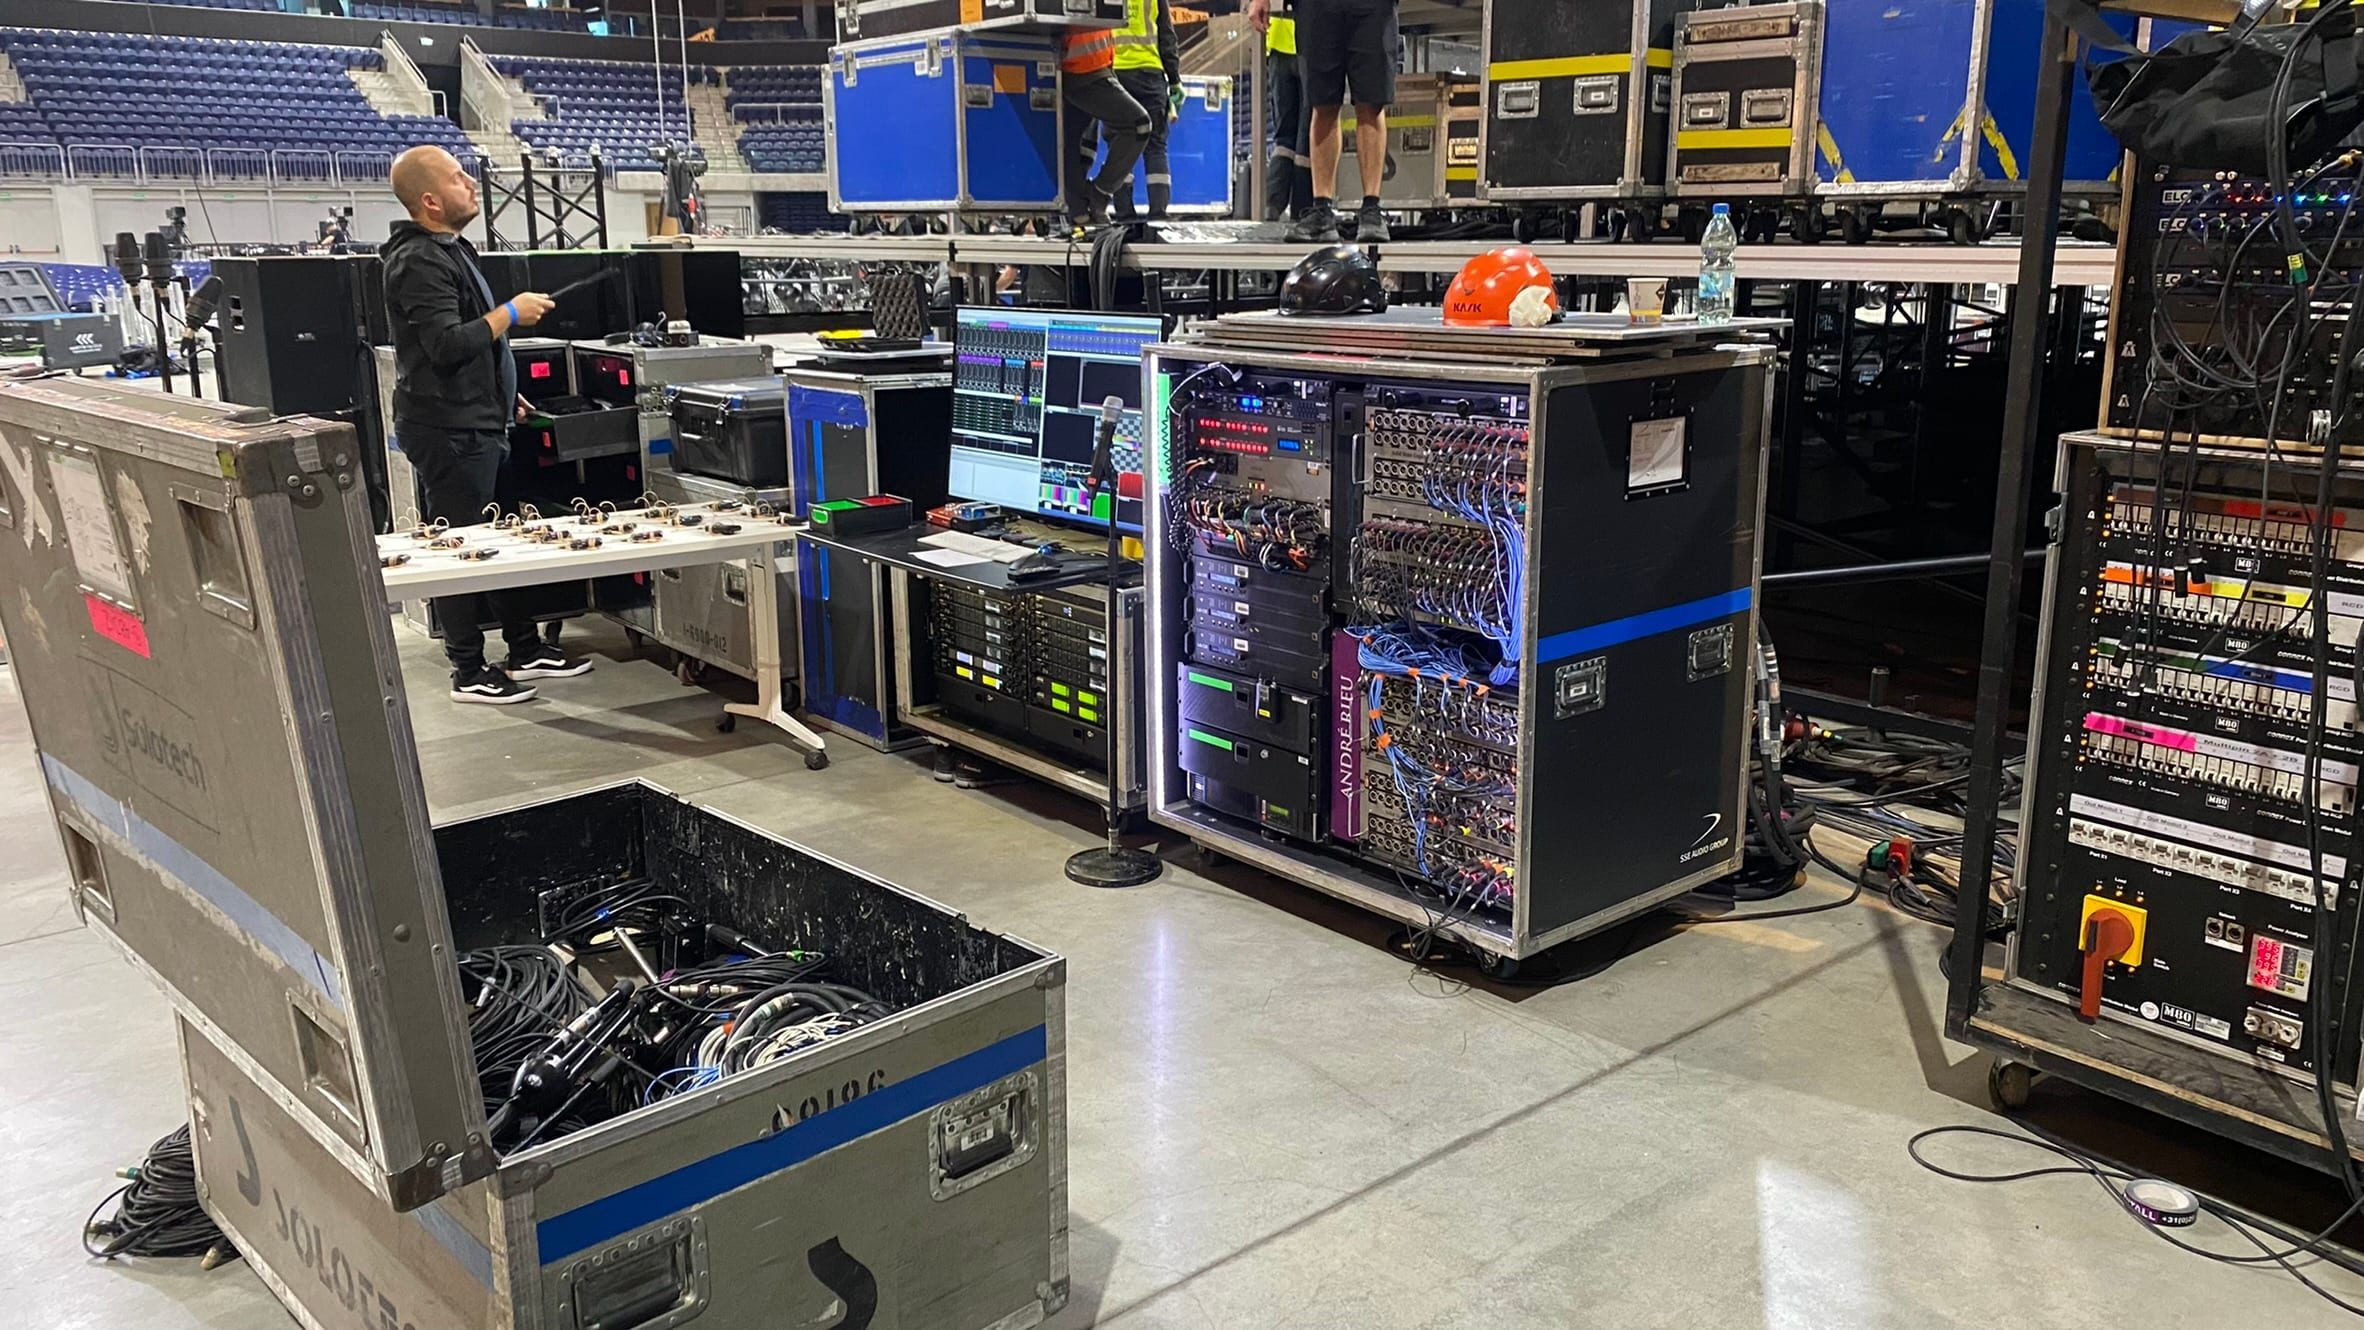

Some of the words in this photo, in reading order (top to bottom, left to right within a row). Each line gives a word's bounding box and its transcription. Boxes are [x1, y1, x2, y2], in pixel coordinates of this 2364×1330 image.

[1453, 303, 1481, 312] KASK
[1340, 675, 1354, 721] RIEU
[1337, 727, 1353, 799] ANDRÉ
[1680, 851, 1692, 863] SSE
[1691, 845, 1709, 858] AUDIO
[2163, 1005, 2193, 1023] M80
